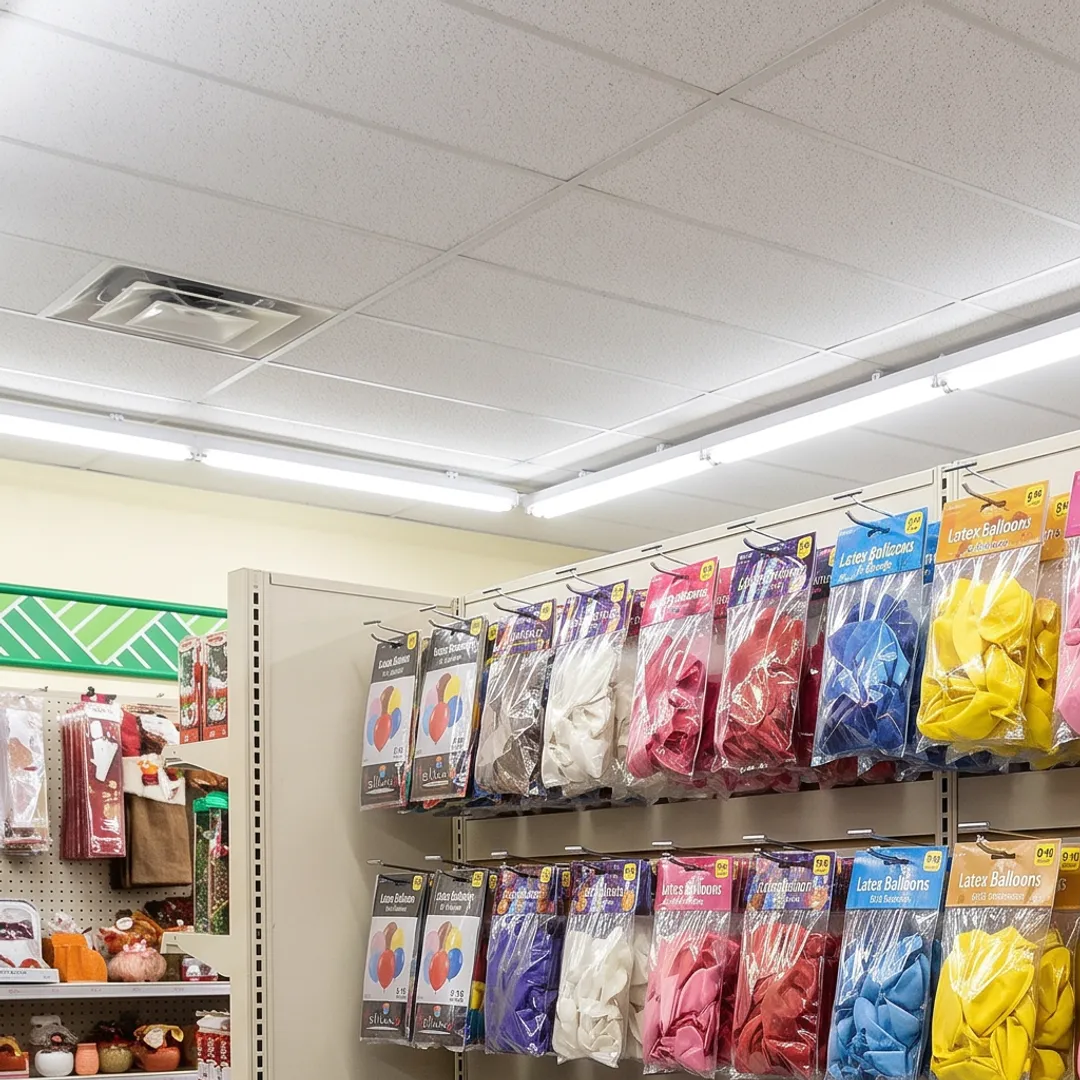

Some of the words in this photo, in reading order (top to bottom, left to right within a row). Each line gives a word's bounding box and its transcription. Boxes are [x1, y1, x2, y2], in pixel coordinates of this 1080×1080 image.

[948, 527, 980, 544] Latex
[982, 515, 1031, 536] Balloons
[884, 875, 930, 893] Balloons
[958, 872, 988, 889] Latex
[989, 870, 1042, 888] Balloons
